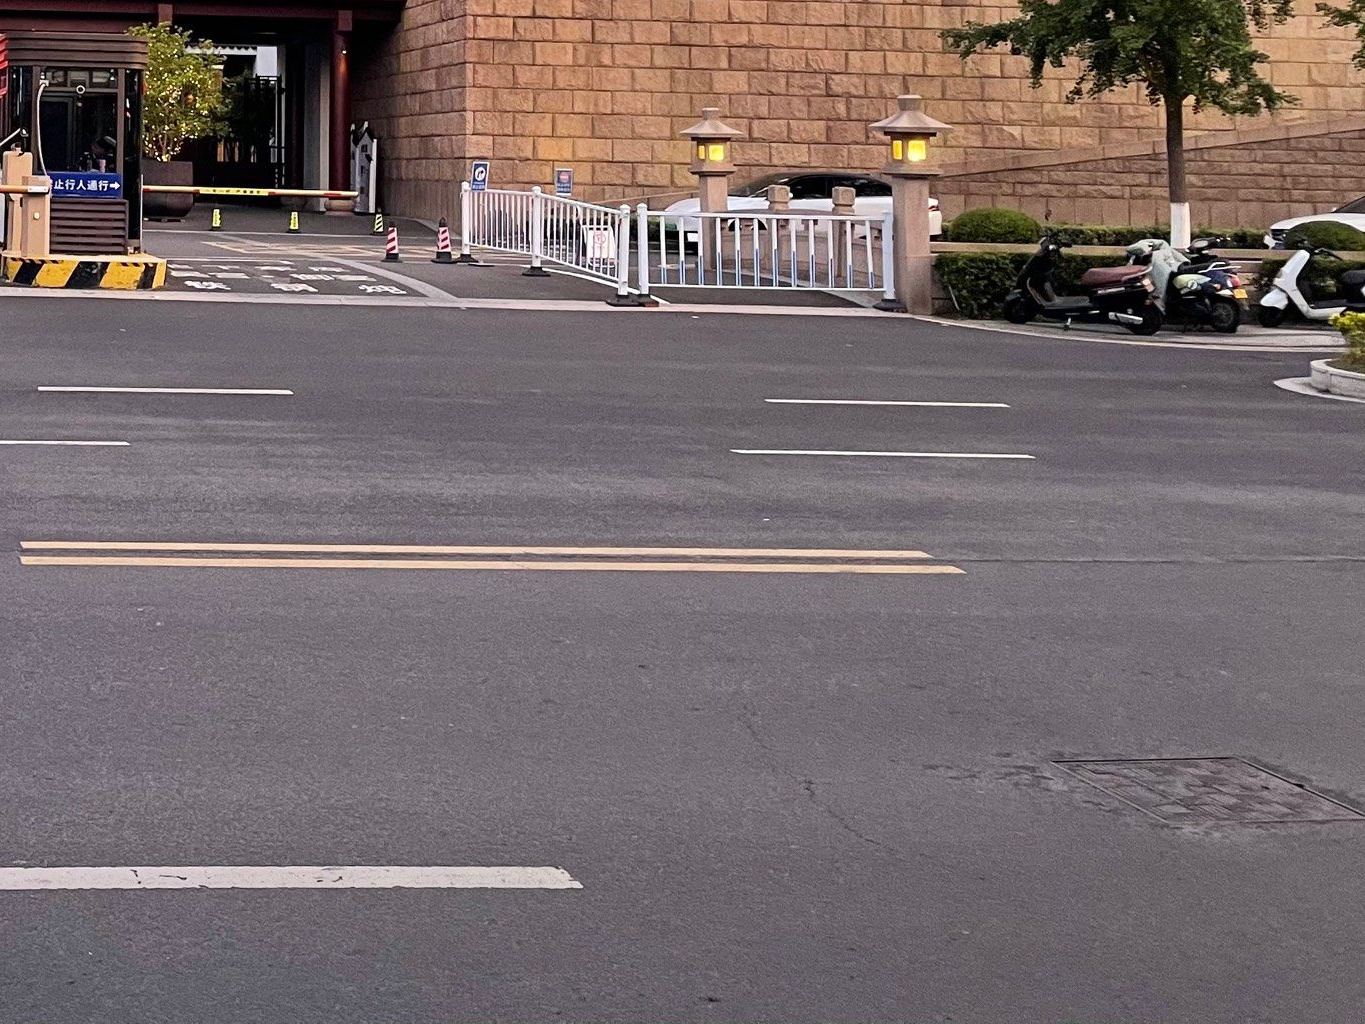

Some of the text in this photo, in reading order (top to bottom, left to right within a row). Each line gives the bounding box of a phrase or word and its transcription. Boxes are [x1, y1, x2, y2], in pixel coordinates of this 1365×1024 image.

[47, 178, 109, 192] 止行人通行
